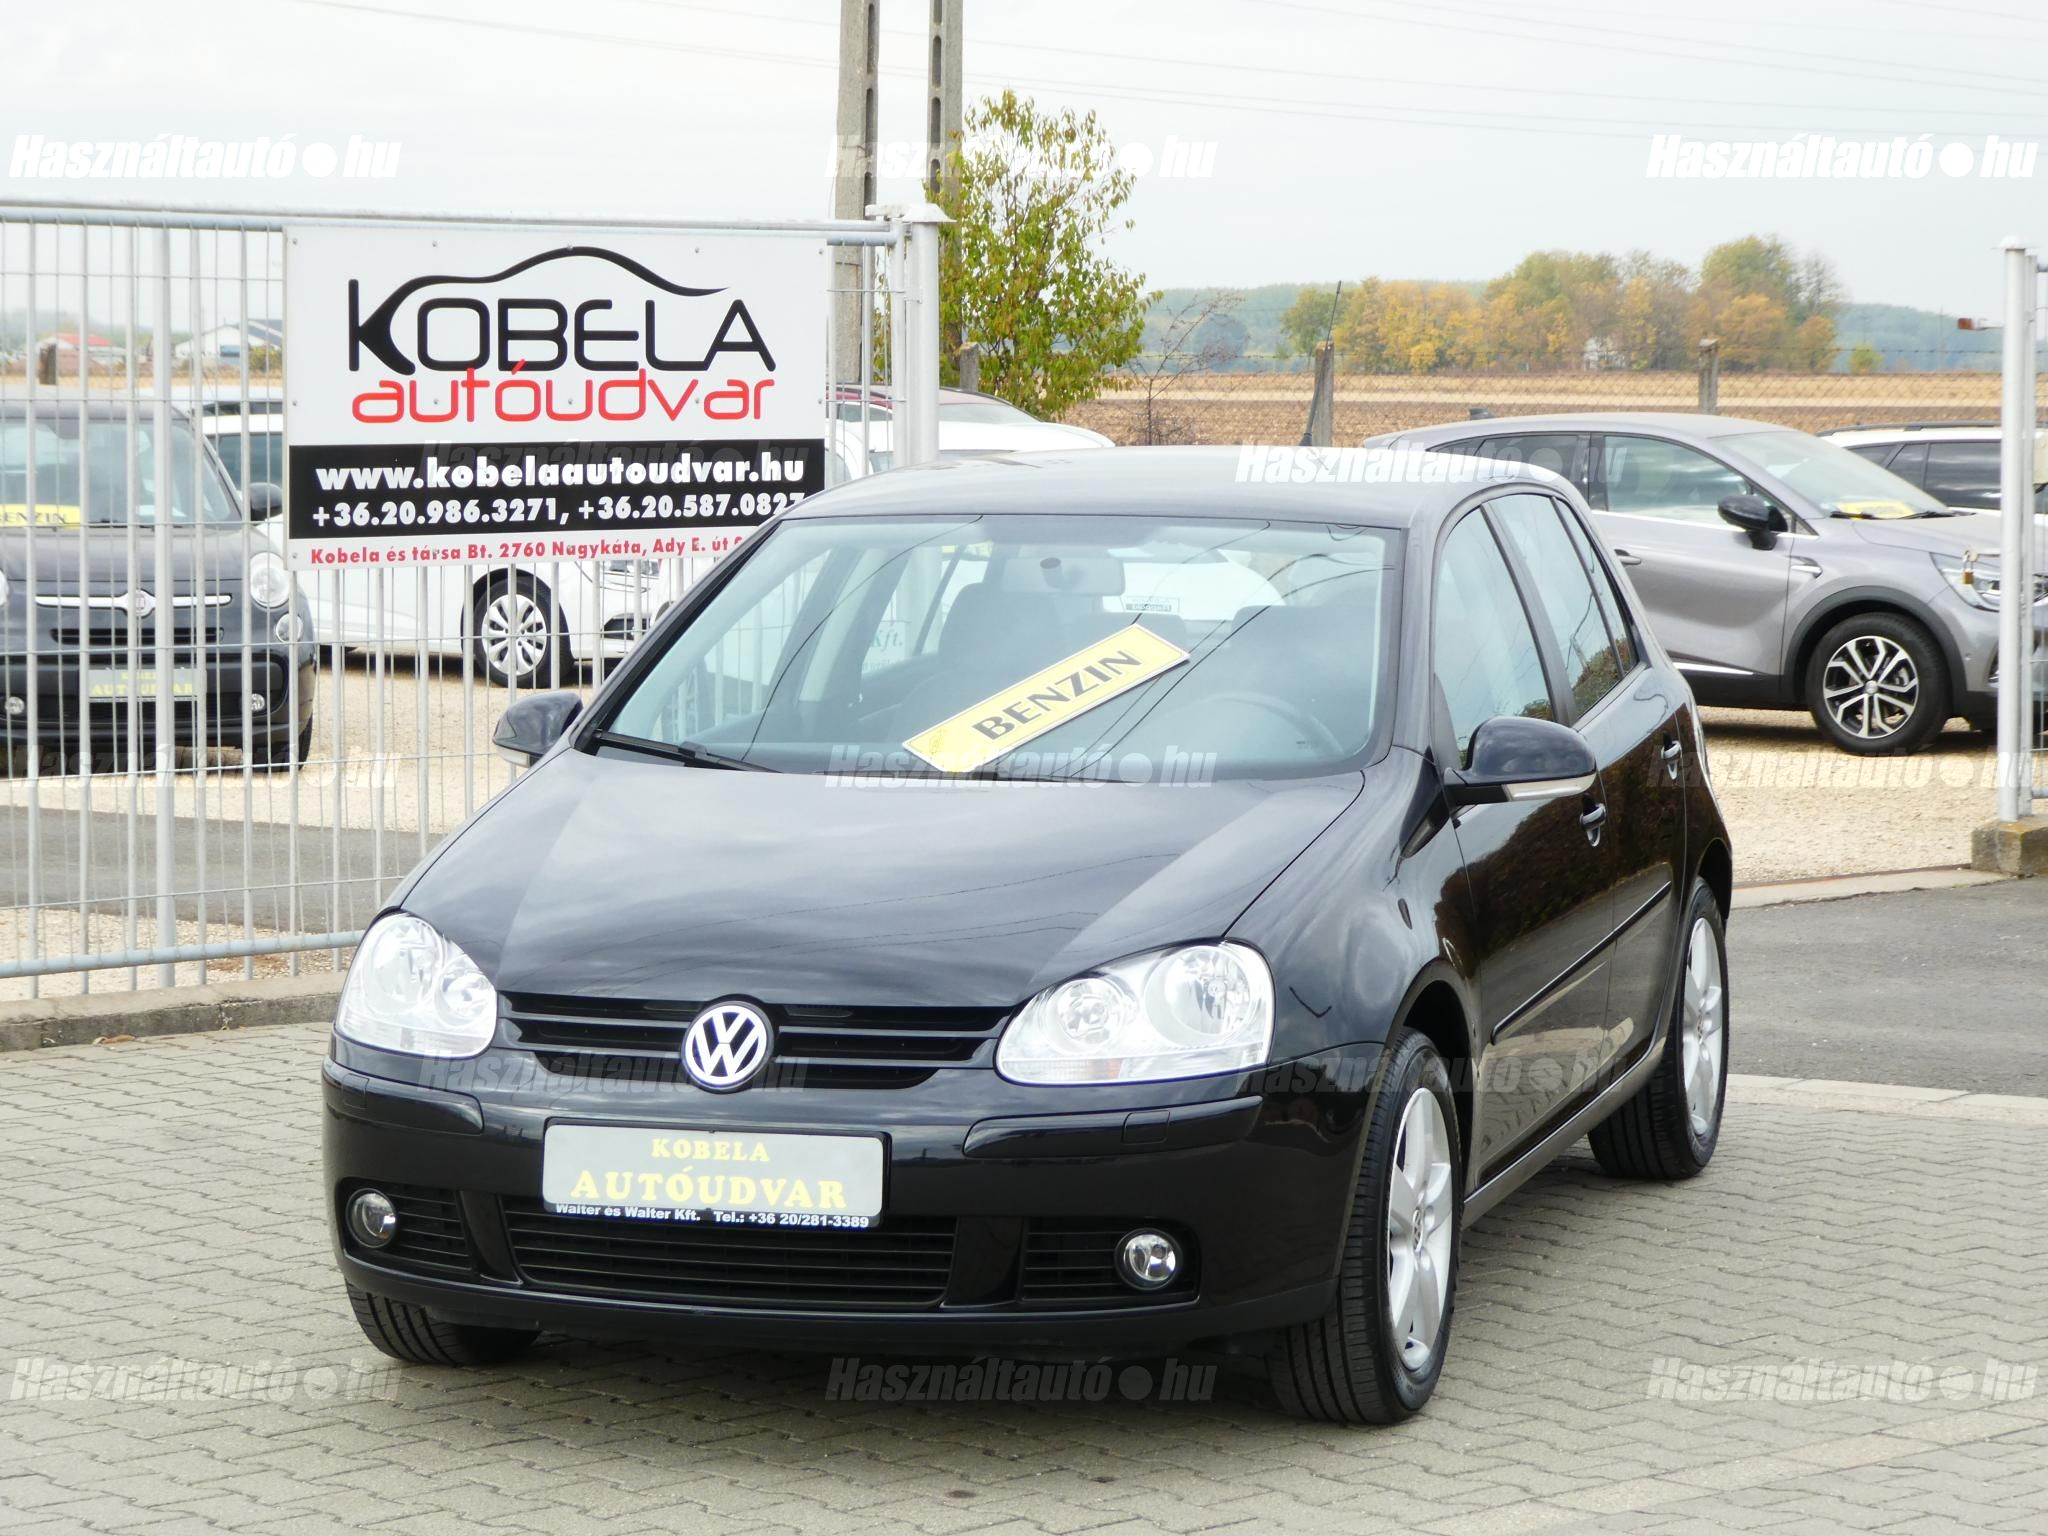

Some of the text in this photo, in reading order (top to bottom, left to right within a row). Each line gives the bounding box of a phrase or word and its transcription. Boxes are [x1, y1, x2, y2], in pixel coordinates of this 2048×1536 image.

[348, 278, 776, 375] KOBELA
[352, 359, 776, 424] autóudvar
[315, 452, 805, 490] www.kobelaautoudvar.hu
[312, 497, 570, 527] +36.20.986.3271,
[311, 547, 380, 564] Kobela
[386, 545, 406, 561] és
[412, 545, 461, 561] társa
[468, 543, 493, 559] Bt.
[499, 542, 545, 558] 2760
[551, 537, 648, 559] Nagykáta,
[652, 536, 686, 556] Ady
[691, 536, 706, 552] E.
[712, 535, 728, 551] út
[971, 649, 1143, 741] BENZIN
[684, 1003, 769, 1088] VW
[652, 1137, 770, 1162] KOBELA
[570, 1164, 848, 1210] AUTÓUDVAR
[674, 1208, 701, 1221] Kft.
[713, 1211, 745, 1223] Tel.:
[748, 1212, 776, 1225] +36
[779, 1213, 869, 1228] 20/281-3389
